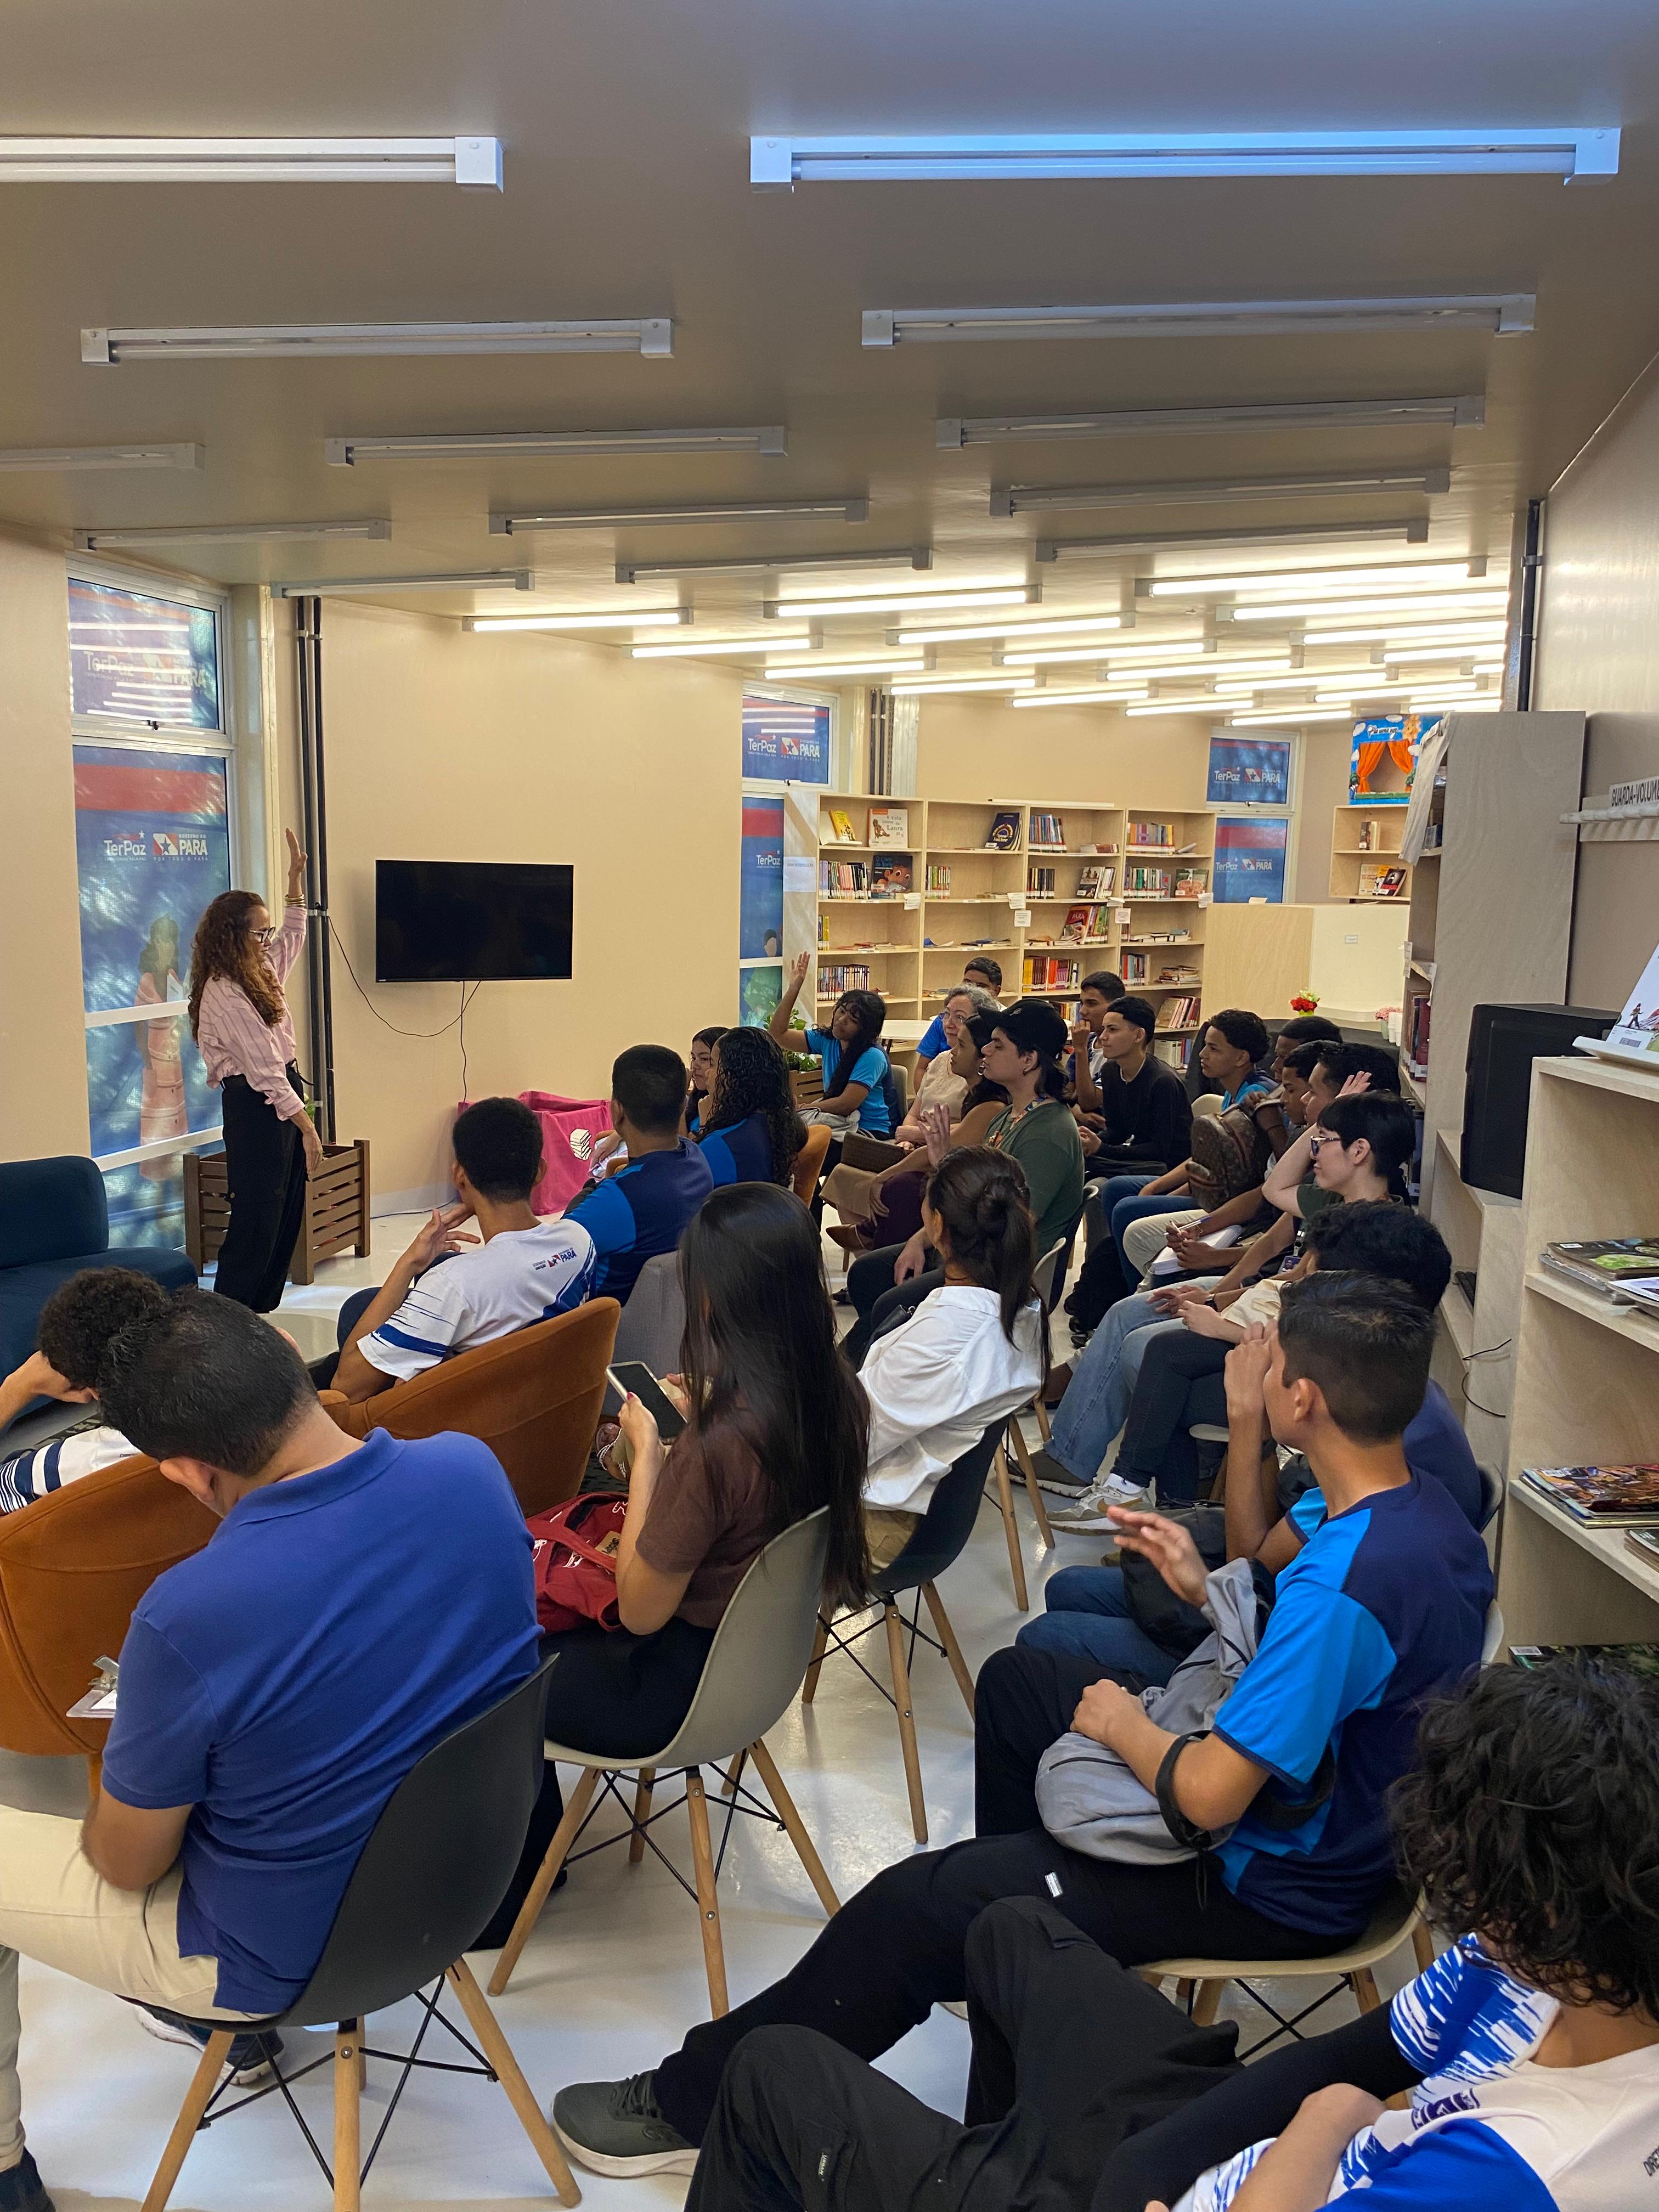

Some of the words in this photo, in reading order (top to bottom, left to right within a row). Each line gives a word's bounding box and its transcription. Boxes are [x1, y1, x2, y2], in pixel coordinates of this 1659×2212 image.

[748, 738, 777, 753] TerPaz
[1214, 770, 1240, 781] TerPaz
[104, 839, 146, 856] TerPaz
[756, 855, 780, 865] TerPaz
[1216, 861, 1238, 871] TerPaz
